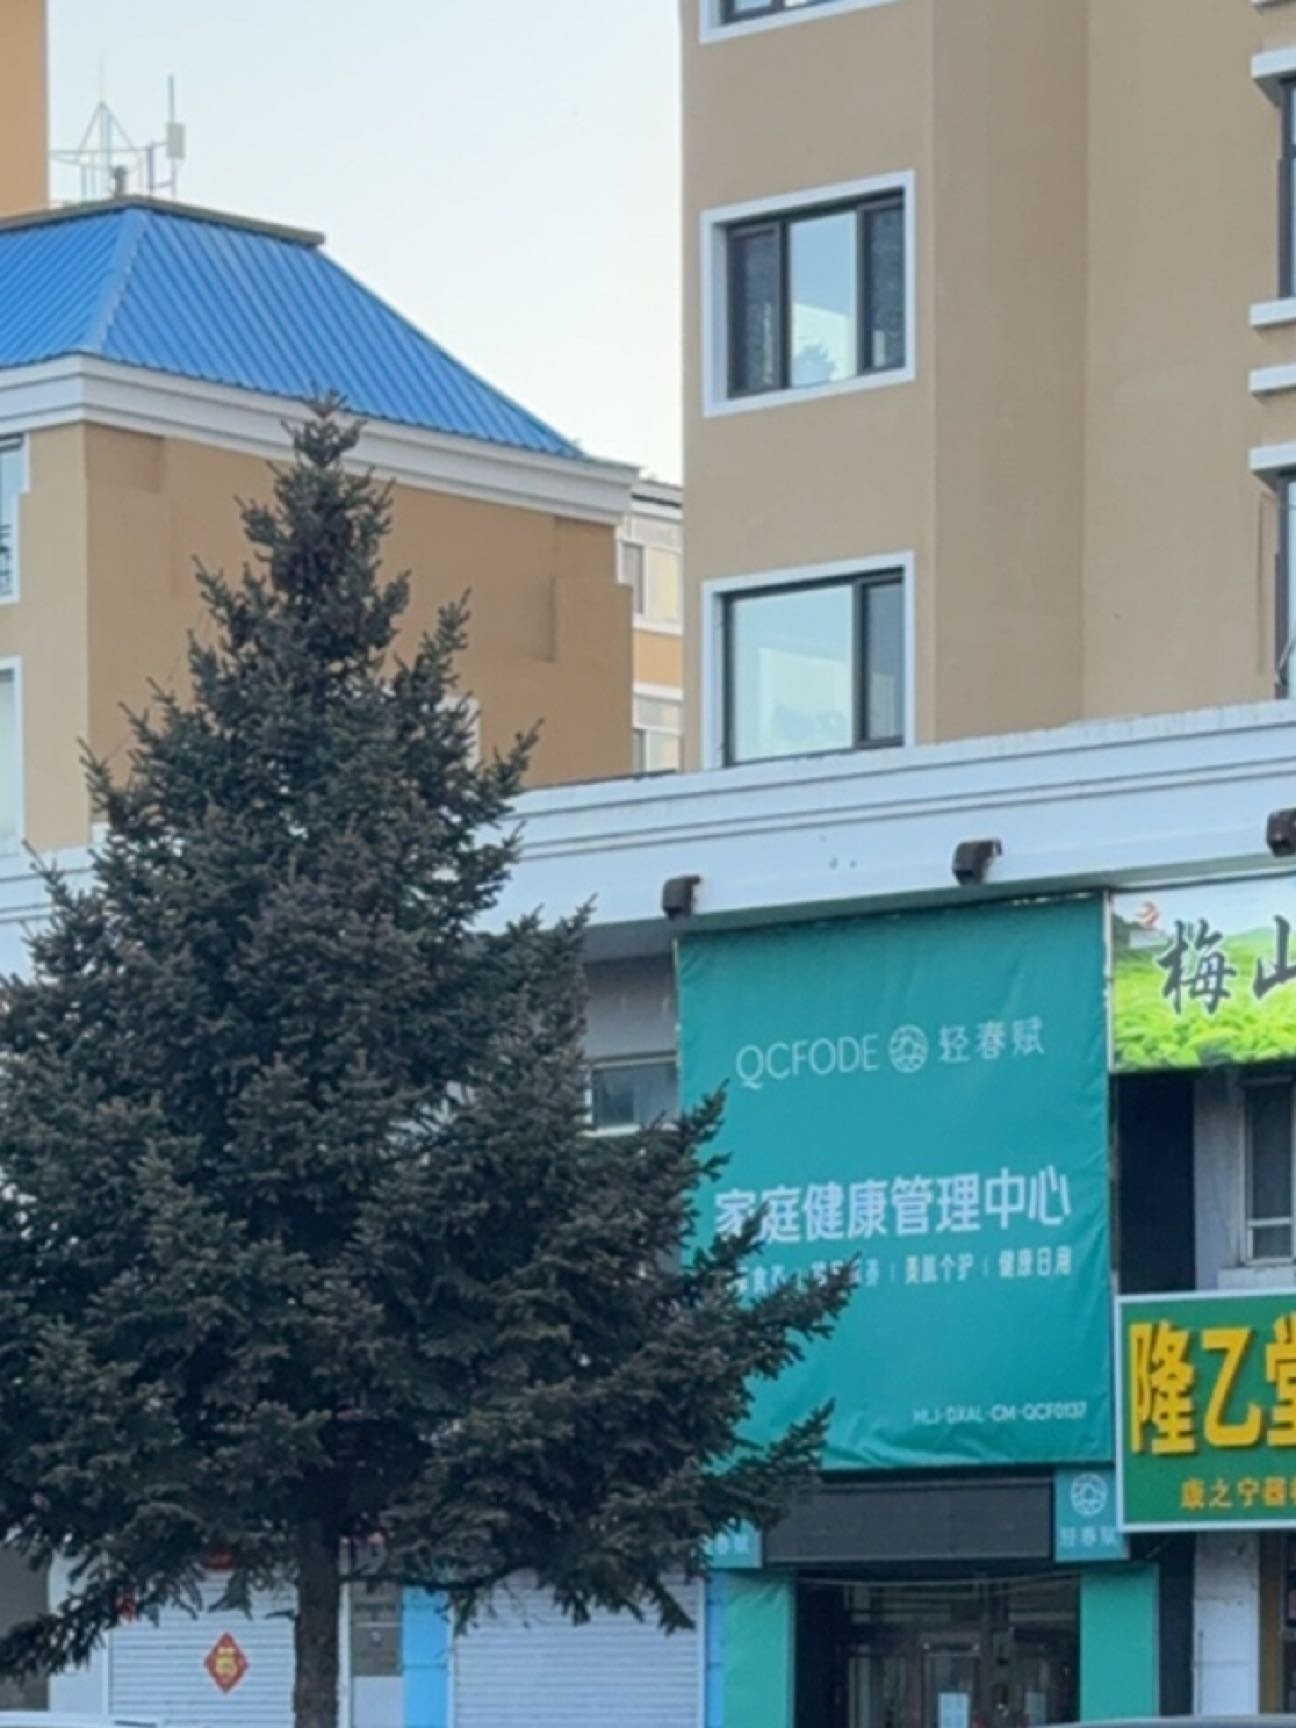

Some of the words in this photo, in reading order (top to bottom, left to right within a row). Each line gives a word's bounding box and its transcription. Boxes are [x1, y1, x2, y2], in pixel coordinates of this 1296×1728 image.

[735, 1034, 879, 1089] QCFODE
[938, 1016, 1044, 1063] 轻春赋
[714, 1166, 1072, 1246] 家庭健康管理中心
